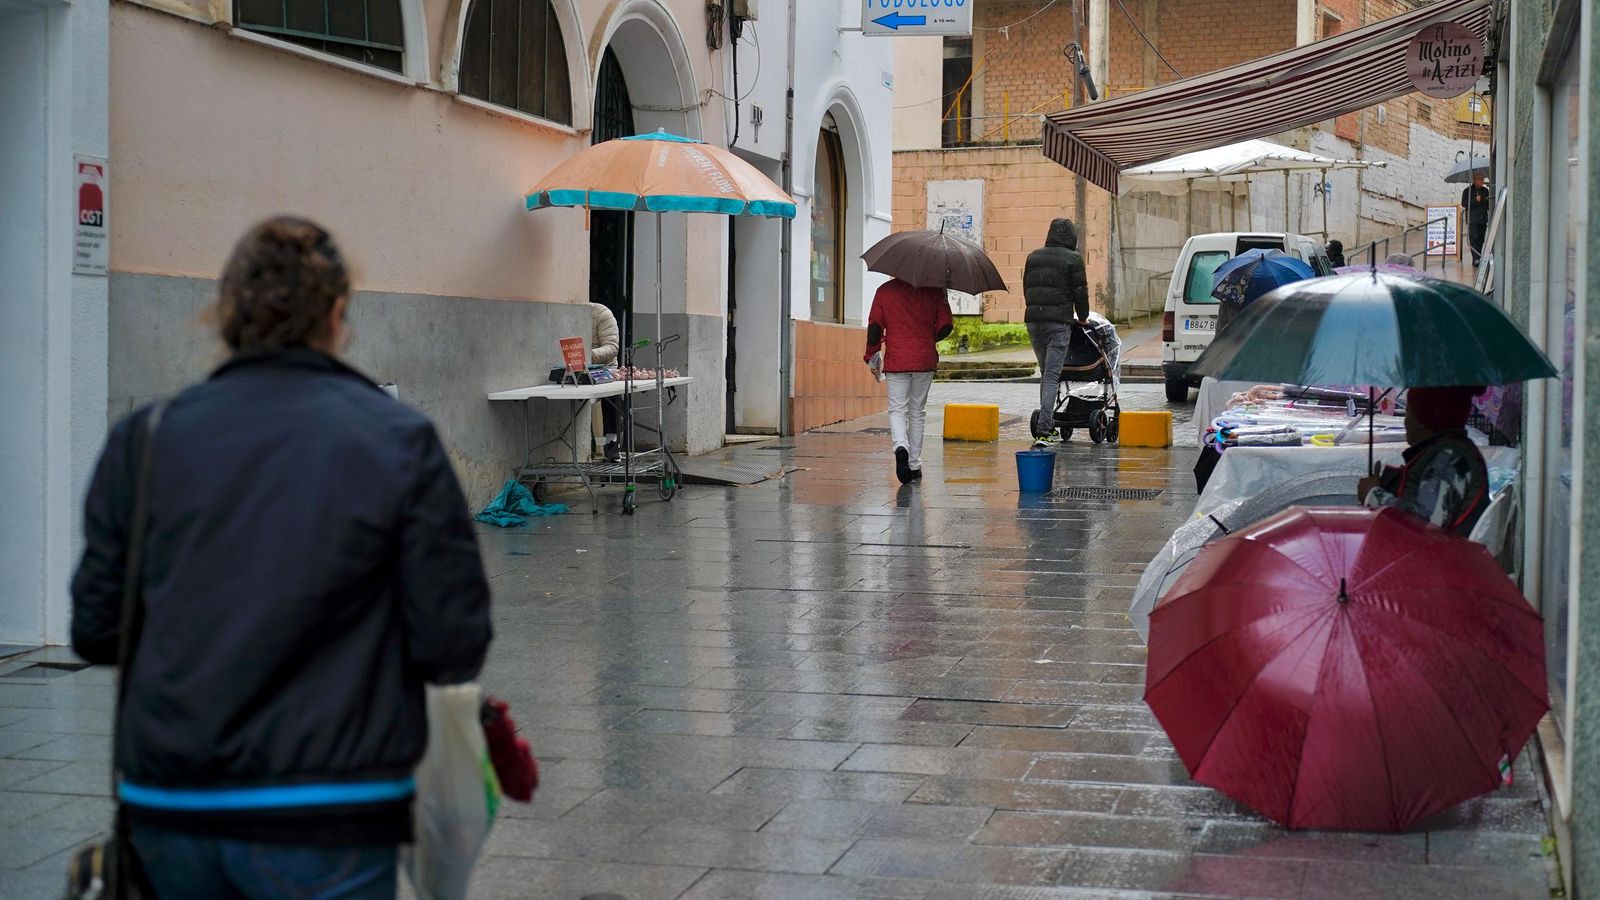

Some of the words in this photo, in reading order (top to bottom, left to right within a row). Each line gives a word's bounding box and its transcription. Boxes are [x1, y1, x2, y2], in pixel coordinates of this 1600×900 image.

[1435, 26, 1444, 41] El
[1419, 39, 1471, 62] Molino
[1423, 67, 1431, 78] de
[80, 209, 102, 225] CGT
[1190, 320, 1208, 329] 8847
